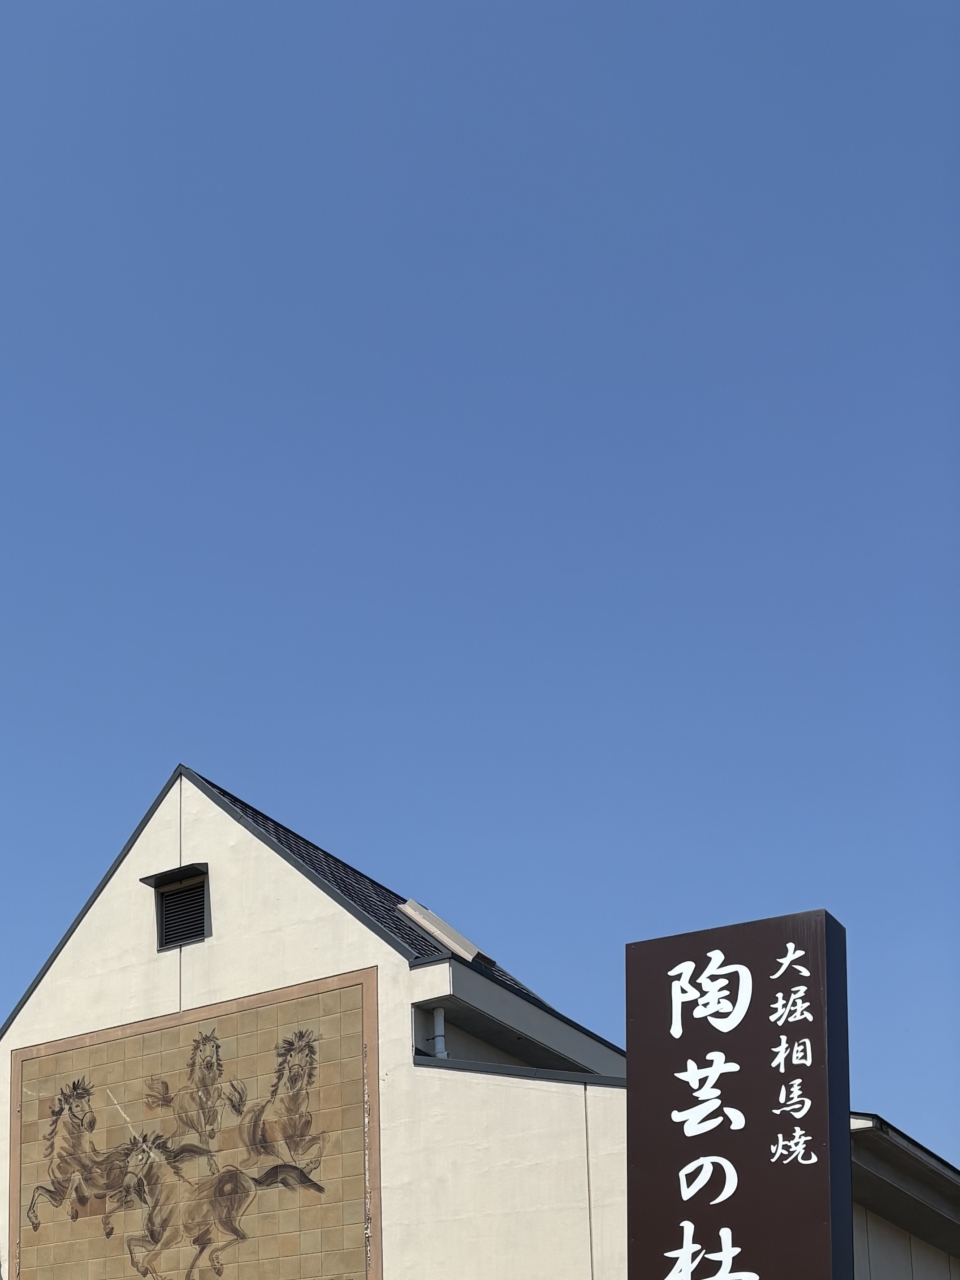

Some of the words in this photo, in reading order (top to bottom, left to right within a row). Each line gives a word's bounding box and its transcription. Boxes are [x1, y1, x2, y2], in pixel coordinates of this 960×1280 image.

[768, 942, 818, 1165] 大堀相馬焼
